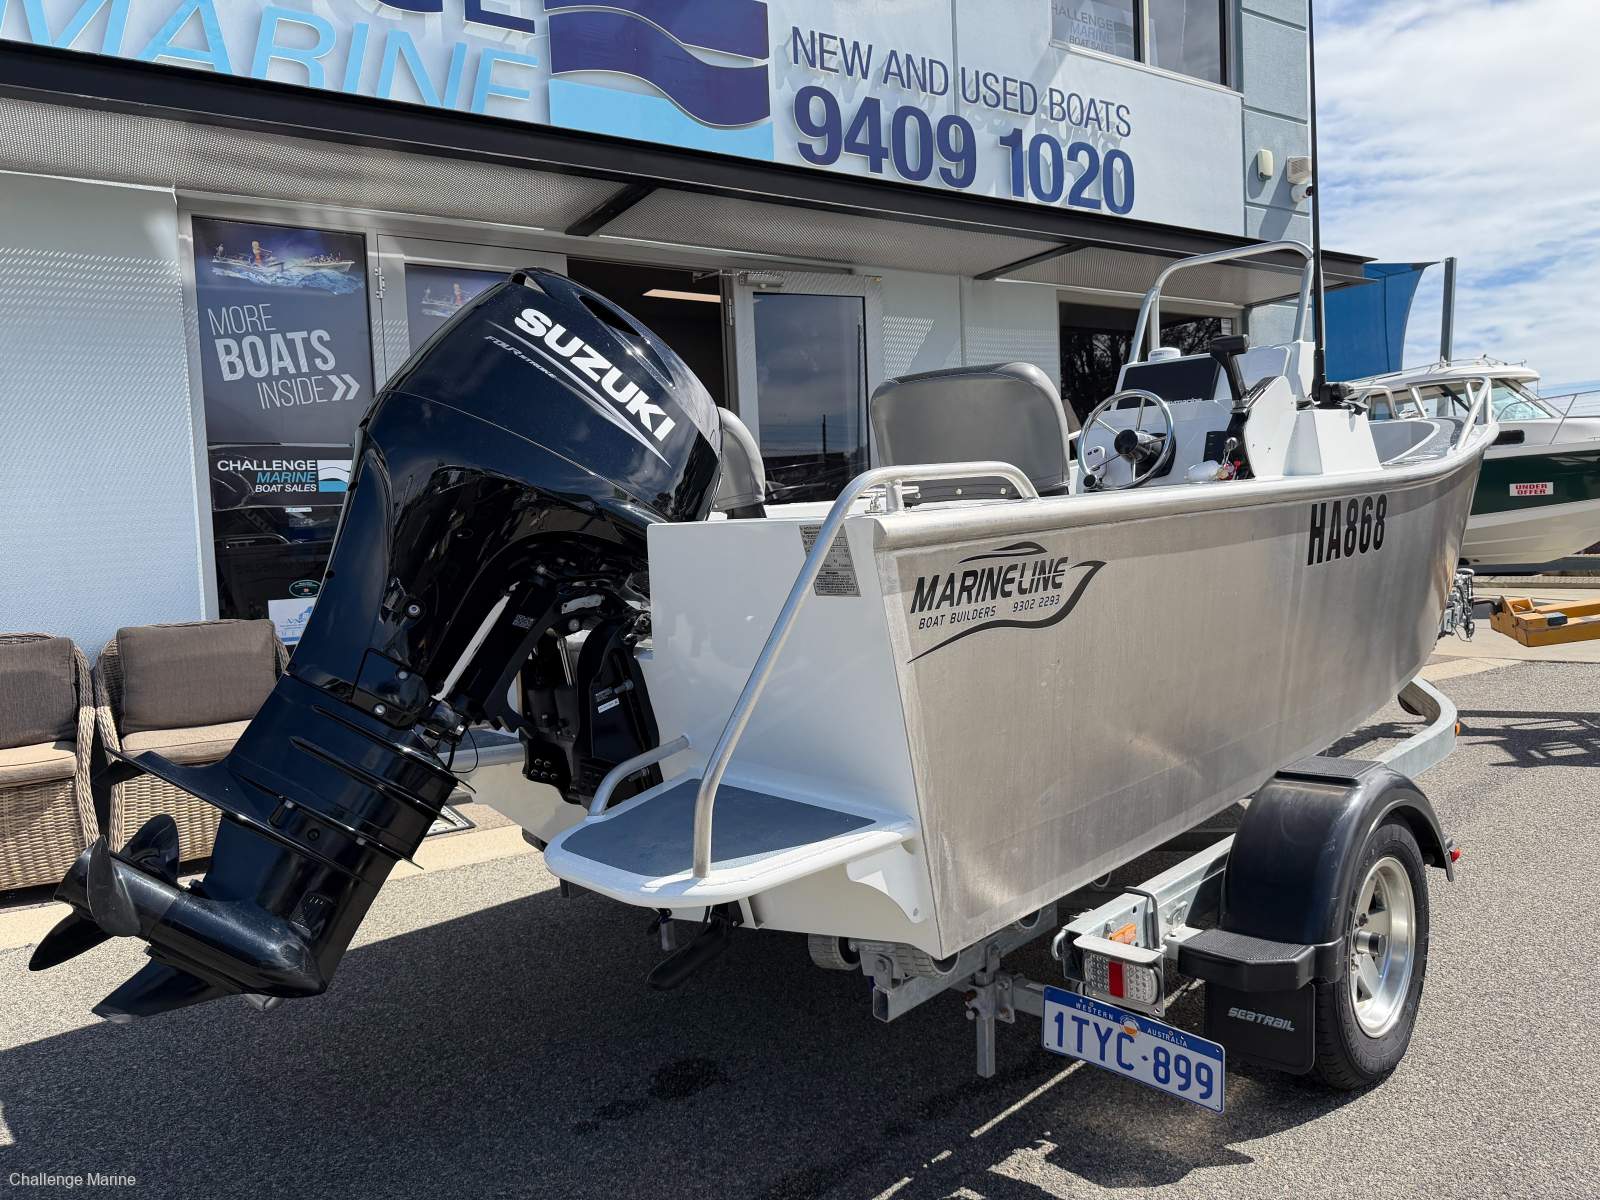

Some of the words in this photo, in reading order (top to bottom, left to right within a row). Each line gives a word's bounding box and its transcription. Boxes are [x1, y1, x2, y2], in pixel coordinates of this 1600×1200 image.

[1051, 4, 1113, 32] HALLENGE
[792, 26, 873, 80] NEW
[883, 50, 949, 95] AND
[961, 67, 1038, 116] USED
[1049, 88, 1132, 138] BOATS
[793, 85, 978, 189] 9409
[1000, 127, 1136, 216] 1020
[207, 304, 277, 336] MORE
[214, 329, 337, 382] BOATS
[256, 375, 329, 410] INSIDE
[514, 308, 676, 442] SUZUKI
[216, 459, 318, 472] CHALLENGE
[256, 471, 317, 484] MARINE
[255, 484, 284, 493] BOAT
[284, 483, 318, 493] SALES
[1307, 494, 1388, 566] HA868
[910, 556, 1069, 614] MARINELINE
[918, 614, 945, 630] BOAT
[949, 606, 997, 625] BUILDERS
[1012, 598, 1036, 613] 9302
[1038, 594, 1061, 608] 2293
[1075, 1002, 1114, 1021] WESTERN
[1146, 1027, 1188, 1049] AUSTRALIA
[1228, 1007, 1295, 1032] SEATRAIL
